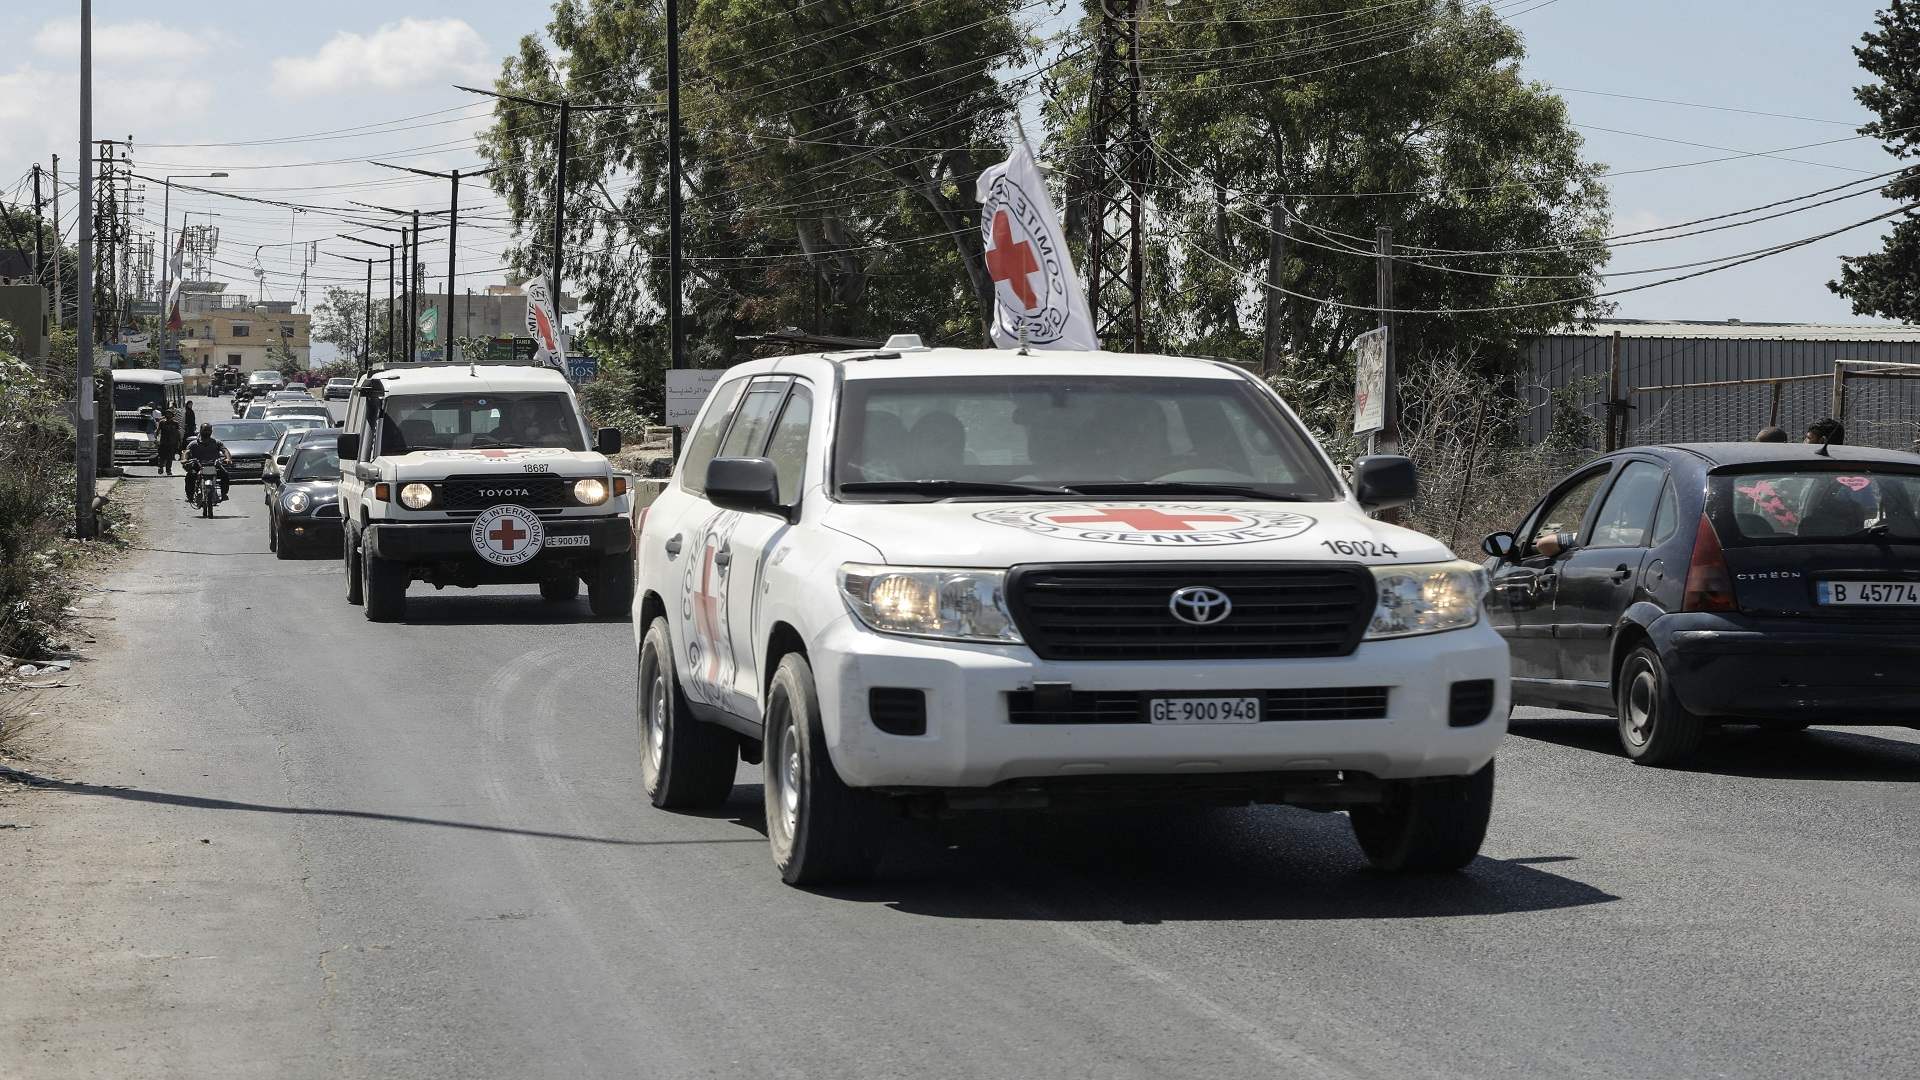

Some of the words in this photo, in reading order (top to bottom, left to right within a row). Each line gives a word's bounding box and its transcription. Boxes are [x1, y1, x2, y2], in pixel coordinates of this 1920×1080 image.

[522, 464, 549, 473] 18687
[478, 488, 529, 497] TOYOTA
[474, 516, 489, 550] COMITE
[489, 505, 541, 547] INTERNATIONAL
[1080, 530, 1277, 543] GENEVE
[1321, 539, 1398, 559] 16024
[488, 551, 529, 563] GENEVE
[1835, 585, 1847, 602] B
[1860, 585, 1917, 602] 45774
